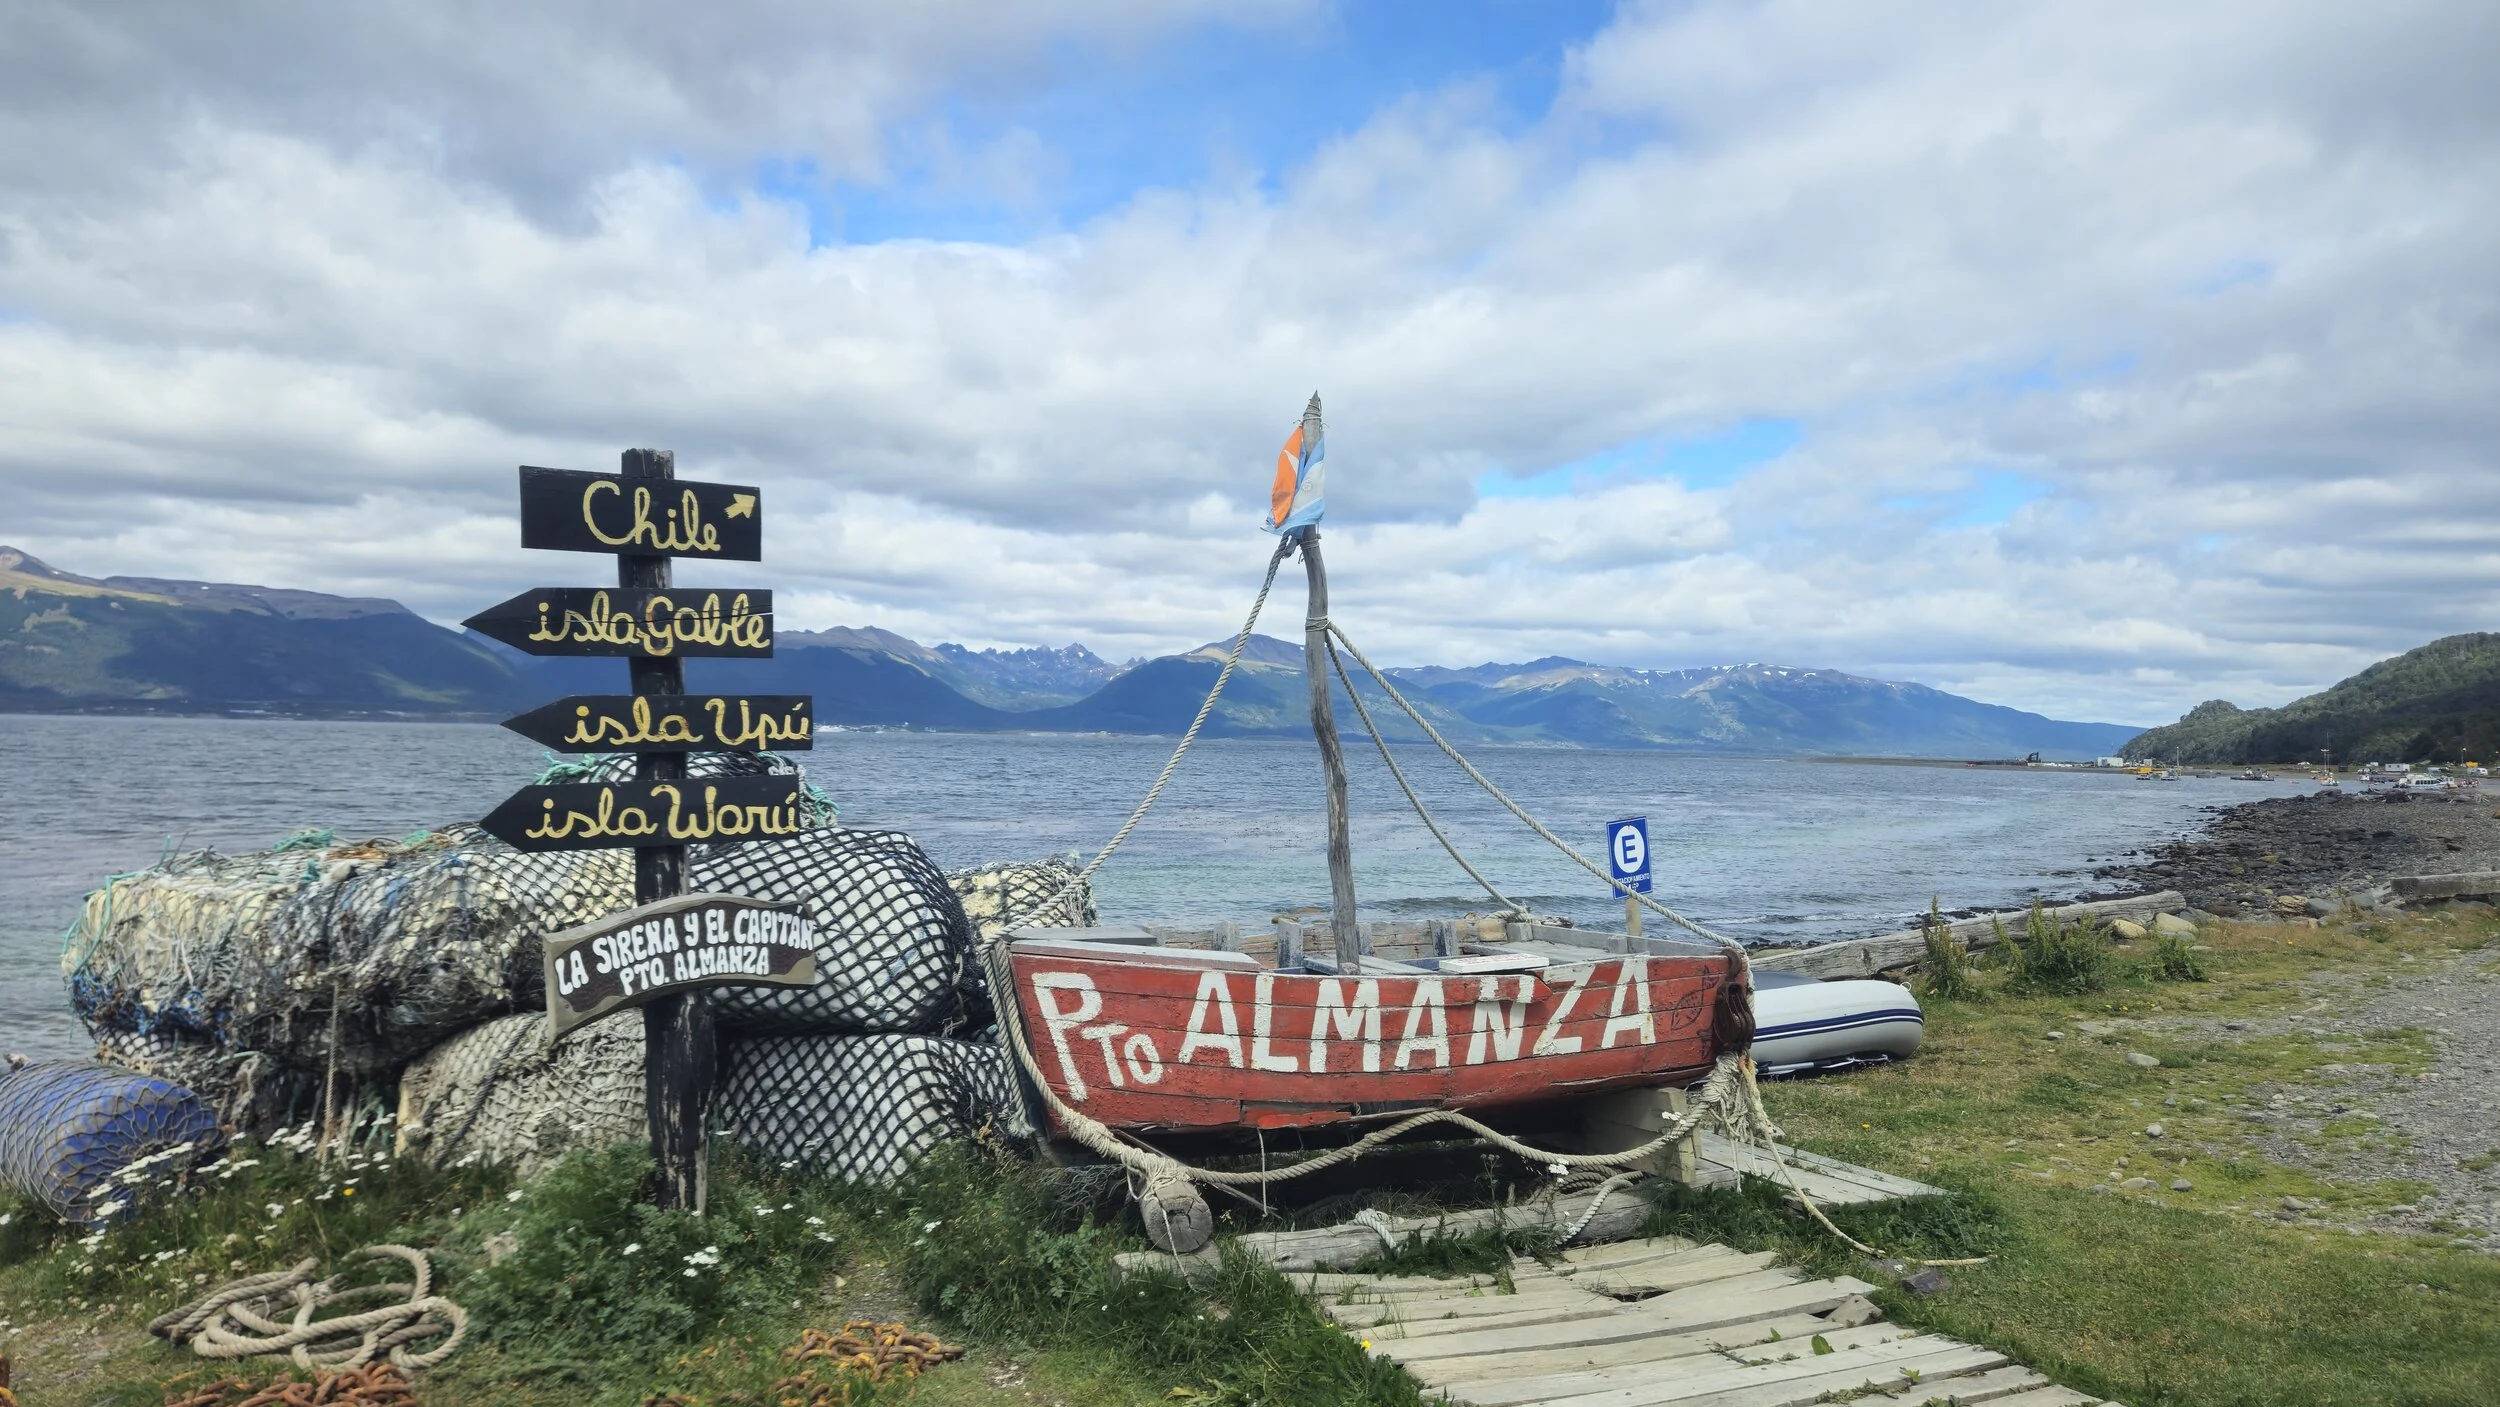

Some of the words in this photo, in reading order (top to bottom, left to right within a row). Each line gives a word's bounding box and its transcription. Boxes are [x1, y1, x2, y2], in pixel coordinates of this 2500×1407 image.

[582, 480, 721, 552] Chile
[529, 590, 641, 645] isla
[636, 593, 770, 656] Gable
[564, 696, 704, 745] isla
[705, 697, 813, 750] Upú
[525, 787, 657, 839] isla
[650, 785, 800, 840] Warú
[1622, 834, 1638, 864] E
[554, 950, 589, 996] LA
[592, 917, 680, 974] SIRENA
[684, 912, 699, 947] Y
[705, 909, 729, 944] EL
[733, 905, 816, 951] CAPITÁN
[620, 958, 670, 996] PTO.
[674, 945, 770, 982] ALMANZA
[1178, 954, 1657, 1074] ALMANZA
